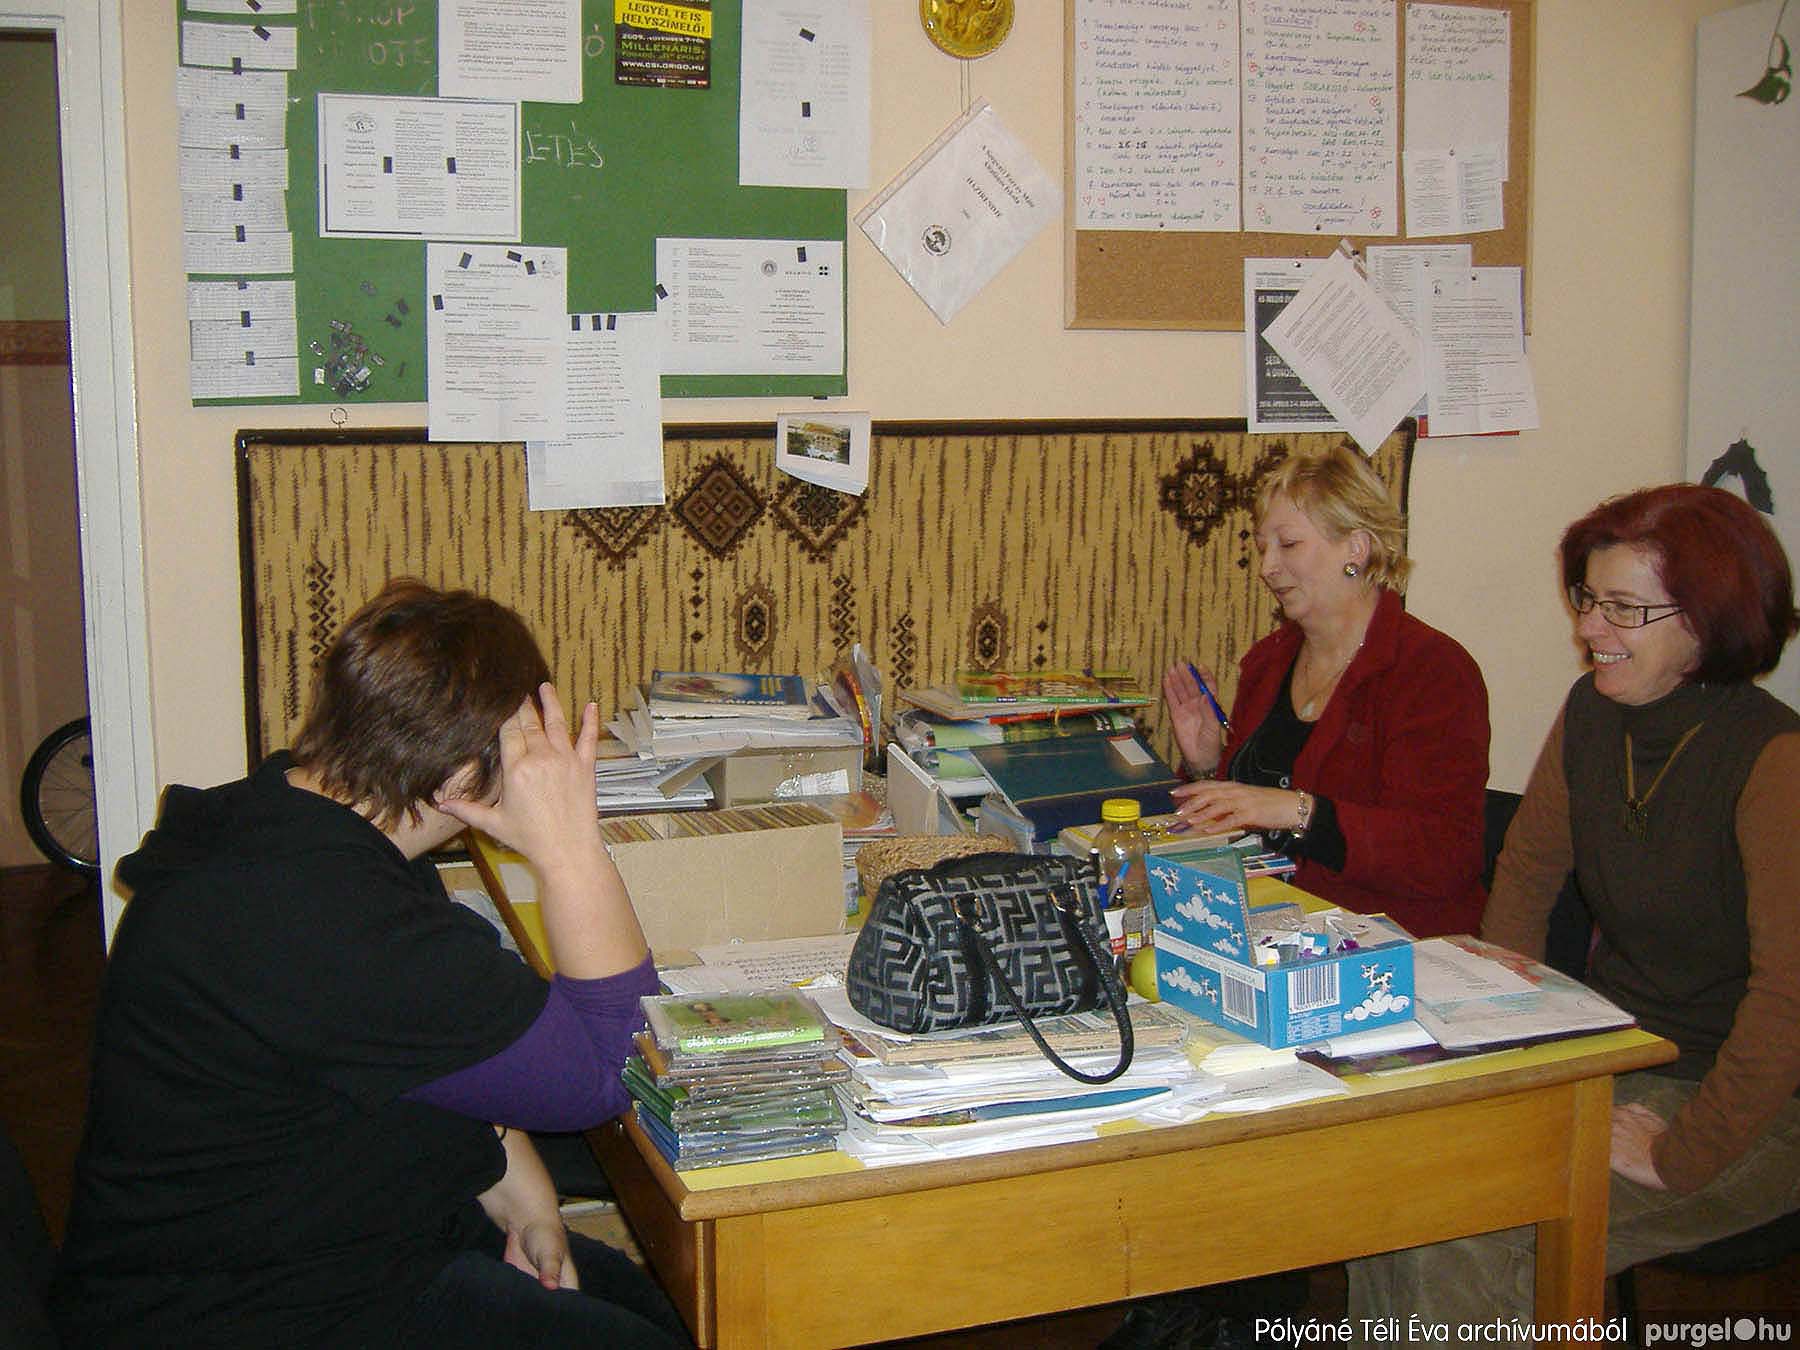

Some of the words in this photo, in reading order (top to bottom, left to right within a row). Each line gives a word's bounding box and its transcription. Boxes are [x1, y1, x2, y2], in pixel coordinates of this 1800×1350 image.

[628, 2, 671, 17] LEGYÉL
[674, 9, 688, 20] TE
[689, 11, 702, 22] IS
